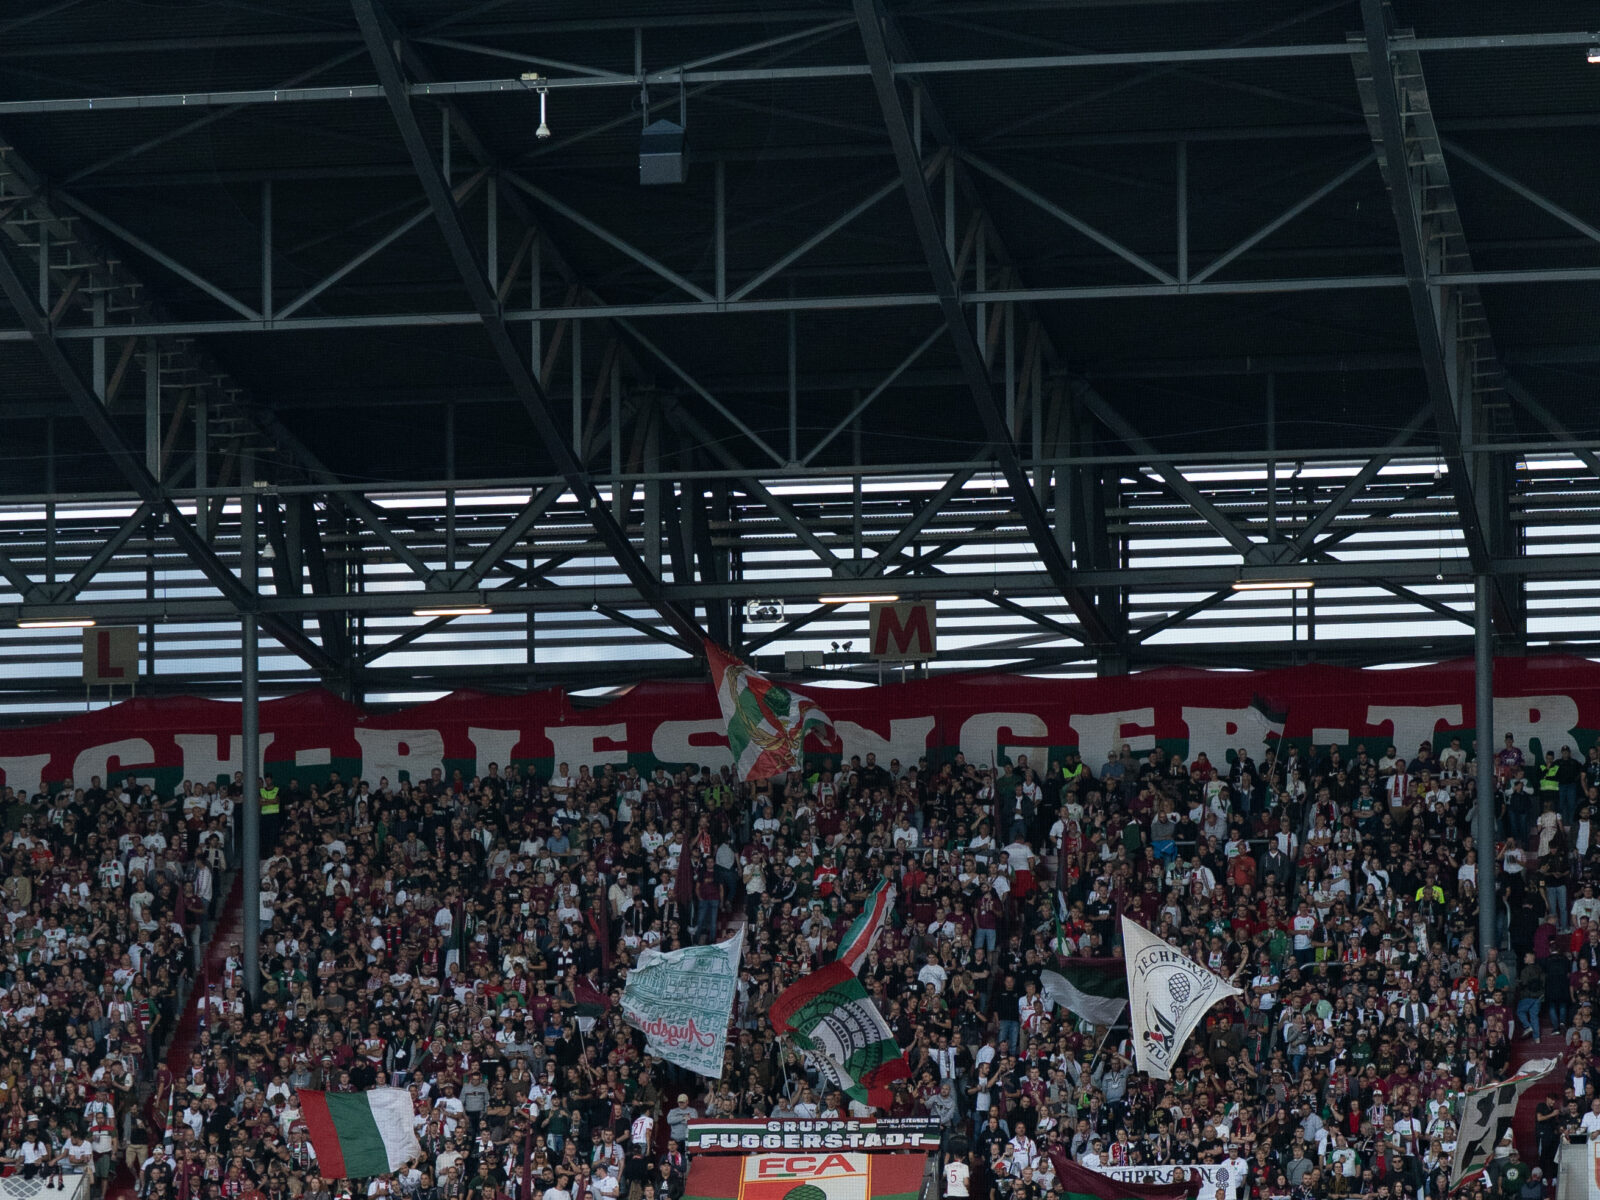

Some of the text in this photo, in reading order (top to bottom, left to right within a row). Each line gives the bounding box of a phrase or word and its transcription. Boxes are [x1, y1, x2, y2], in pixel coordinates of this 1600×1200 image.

[874, 605, 931, 656] M
[97, 631, 125, 678] L
[767, 1120, 861, 1132] GRUPPE
[700, 1133, 924, 1149] FUGGERSTADT
[758, 1154, 856, 1175] FCA
[949, 1169, 957, 1183] 5
